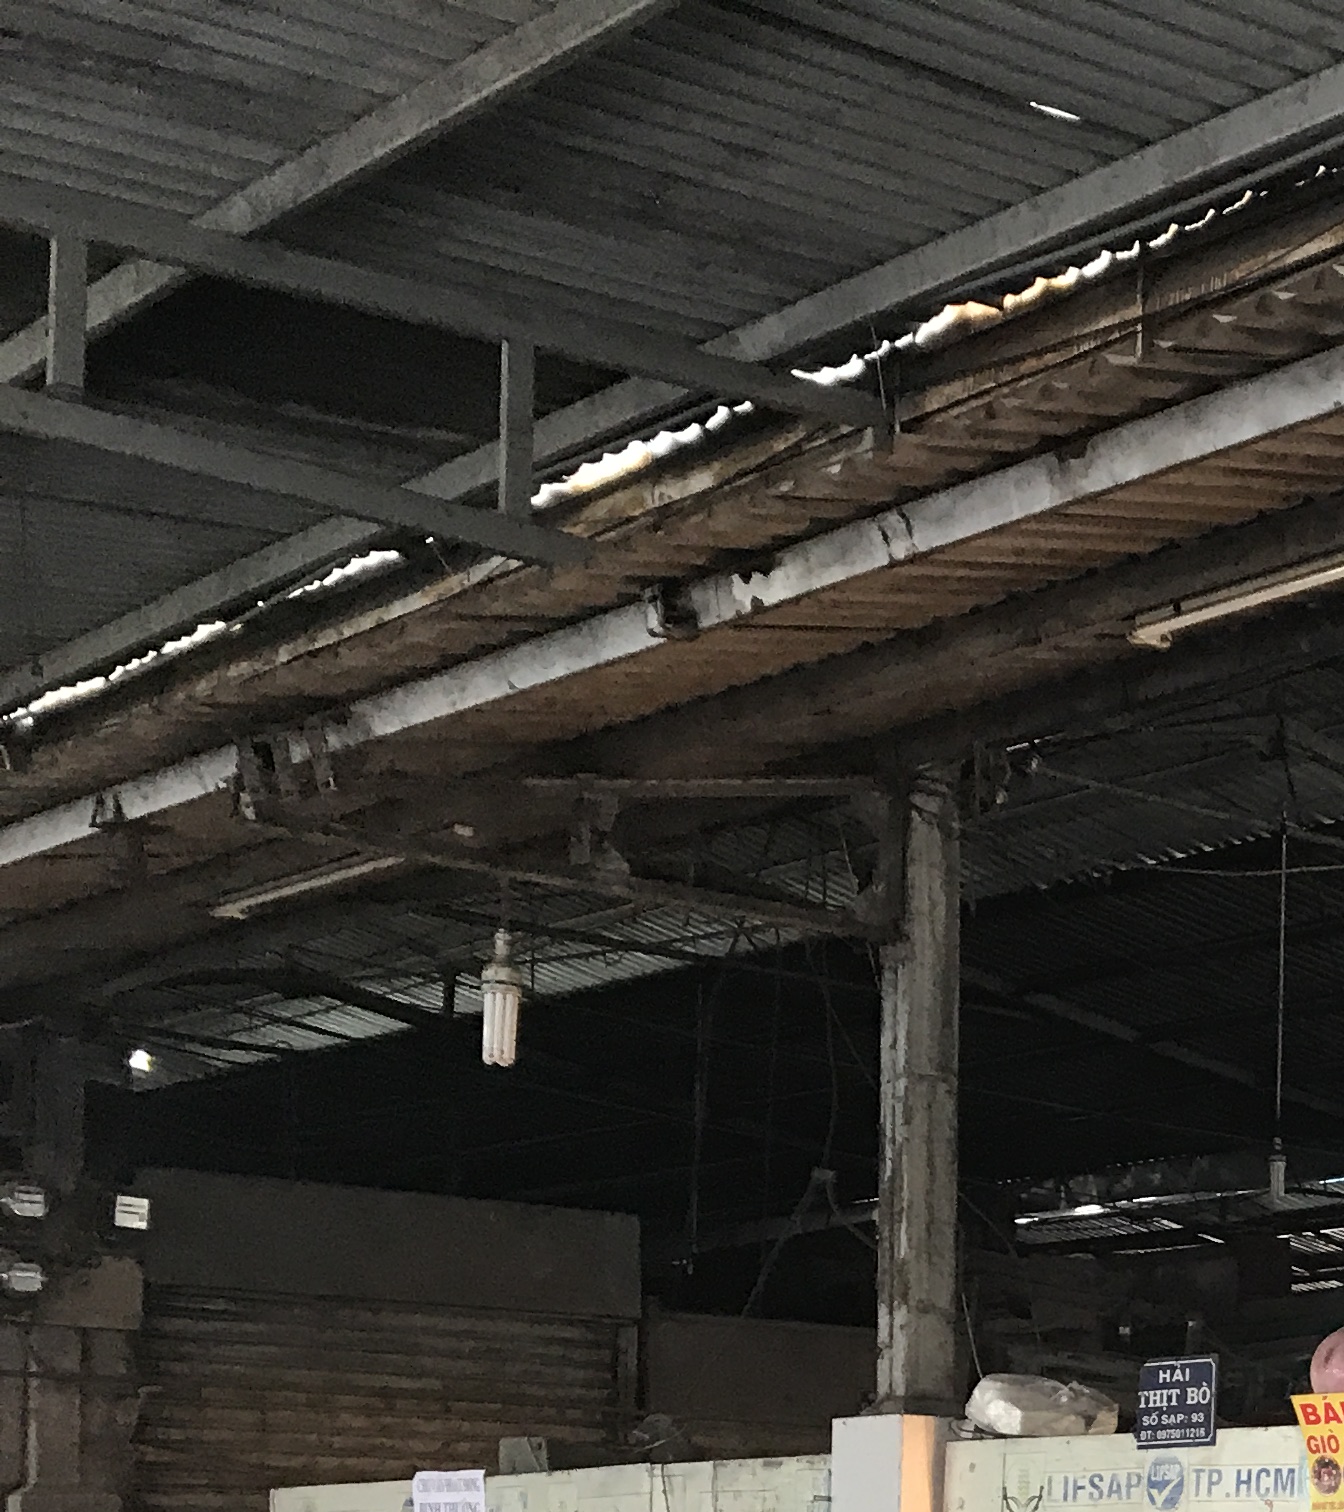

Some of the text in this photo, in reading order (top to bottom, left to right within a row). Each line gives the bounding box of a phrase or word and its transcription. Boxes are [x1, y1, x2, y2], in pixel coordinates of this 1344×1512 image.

[1158, 1363, 1190, 1384] HẢI
[1137, 1381, 1211, 1411] THỊT BÒ
[1142, 1411, 1159, 1426] SỐ
[1190, 1412, 1205, 1423] 93
[1306, 1428, 1341, 1455] GIÒ
[1046, 1471, 1143, 1503] LIFSAP
[1192, 1467, 1297, 1499] TP.HCM
